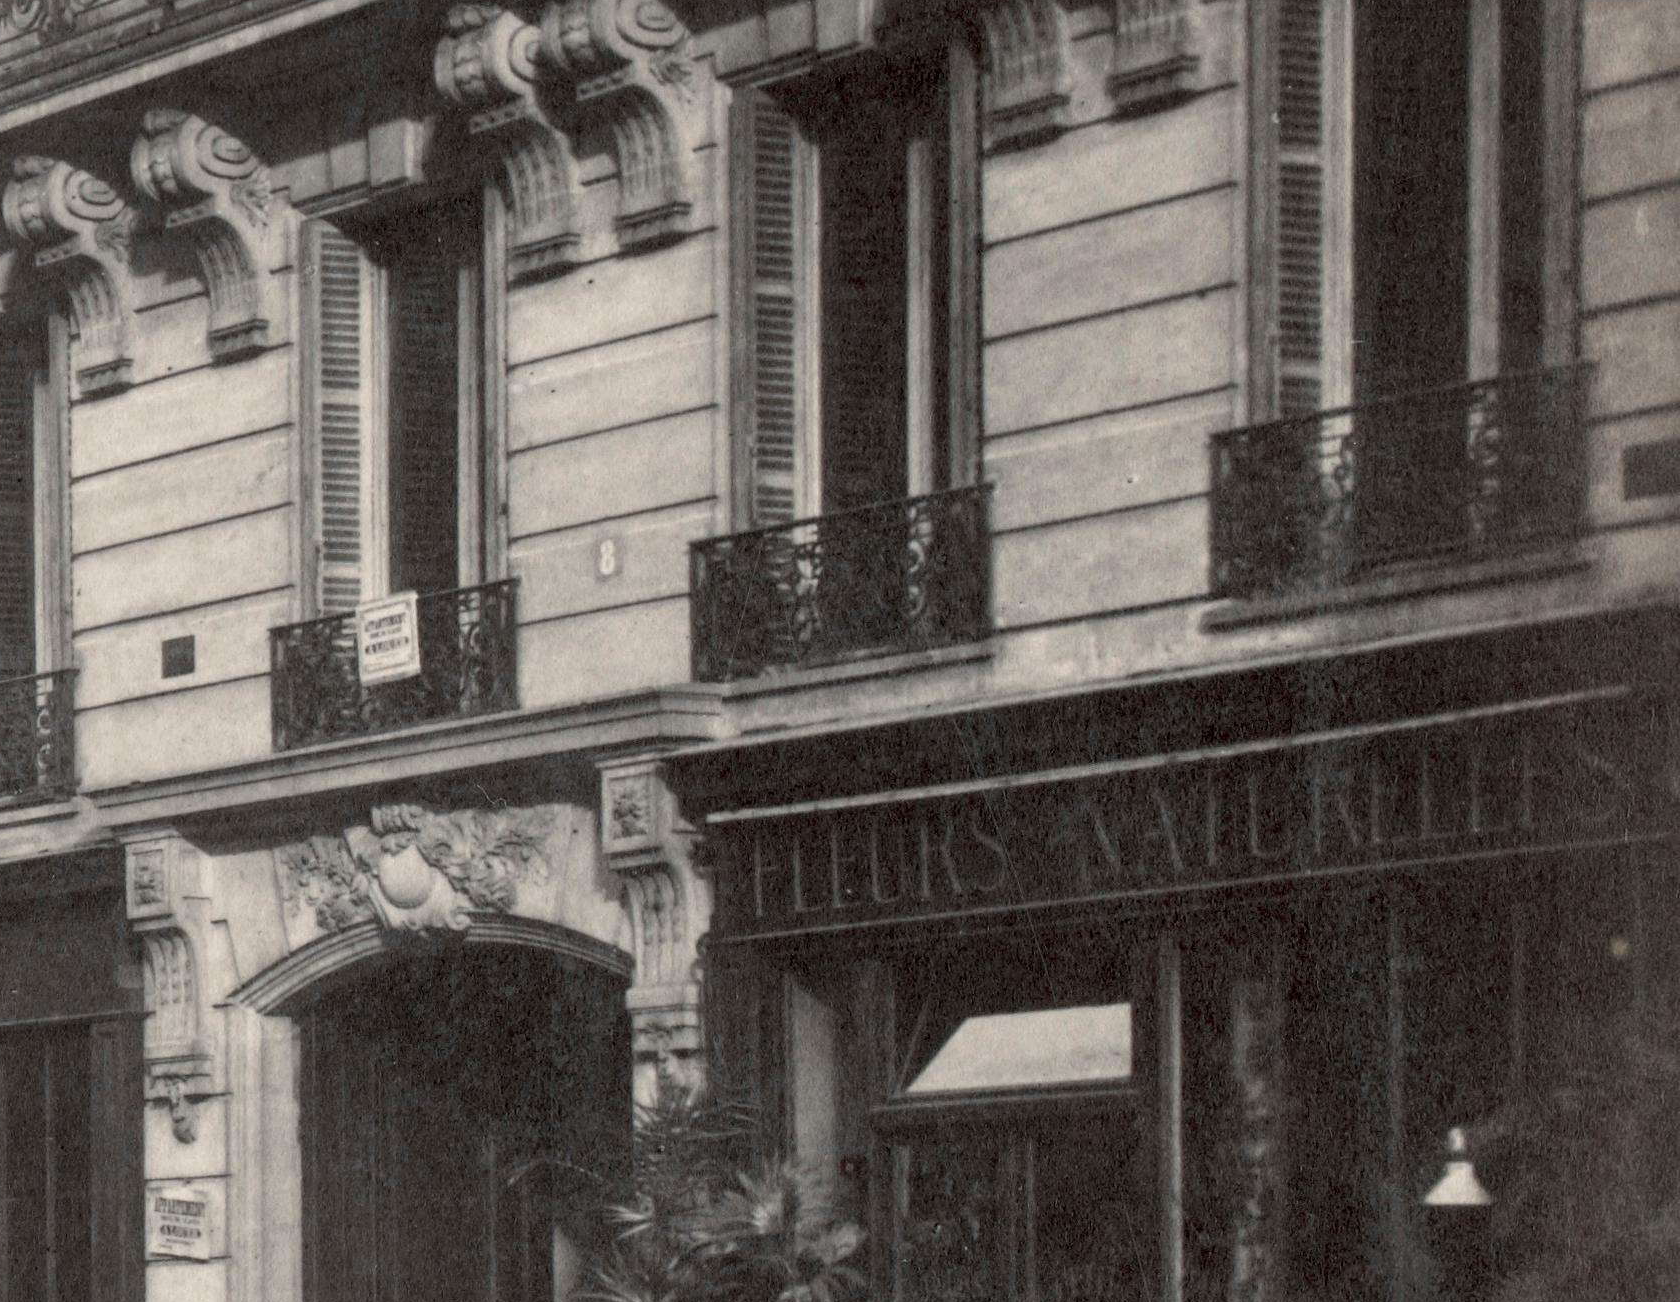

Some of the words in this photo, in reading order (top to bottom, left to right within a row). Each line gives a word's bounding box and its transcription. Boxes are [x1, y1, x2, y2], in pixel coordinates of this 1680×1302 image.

[599, 538, 616, 575] 8
[749, 808, 1012, 918] FLEURS
[1075, 740, 1633, 888] NATURELLES
